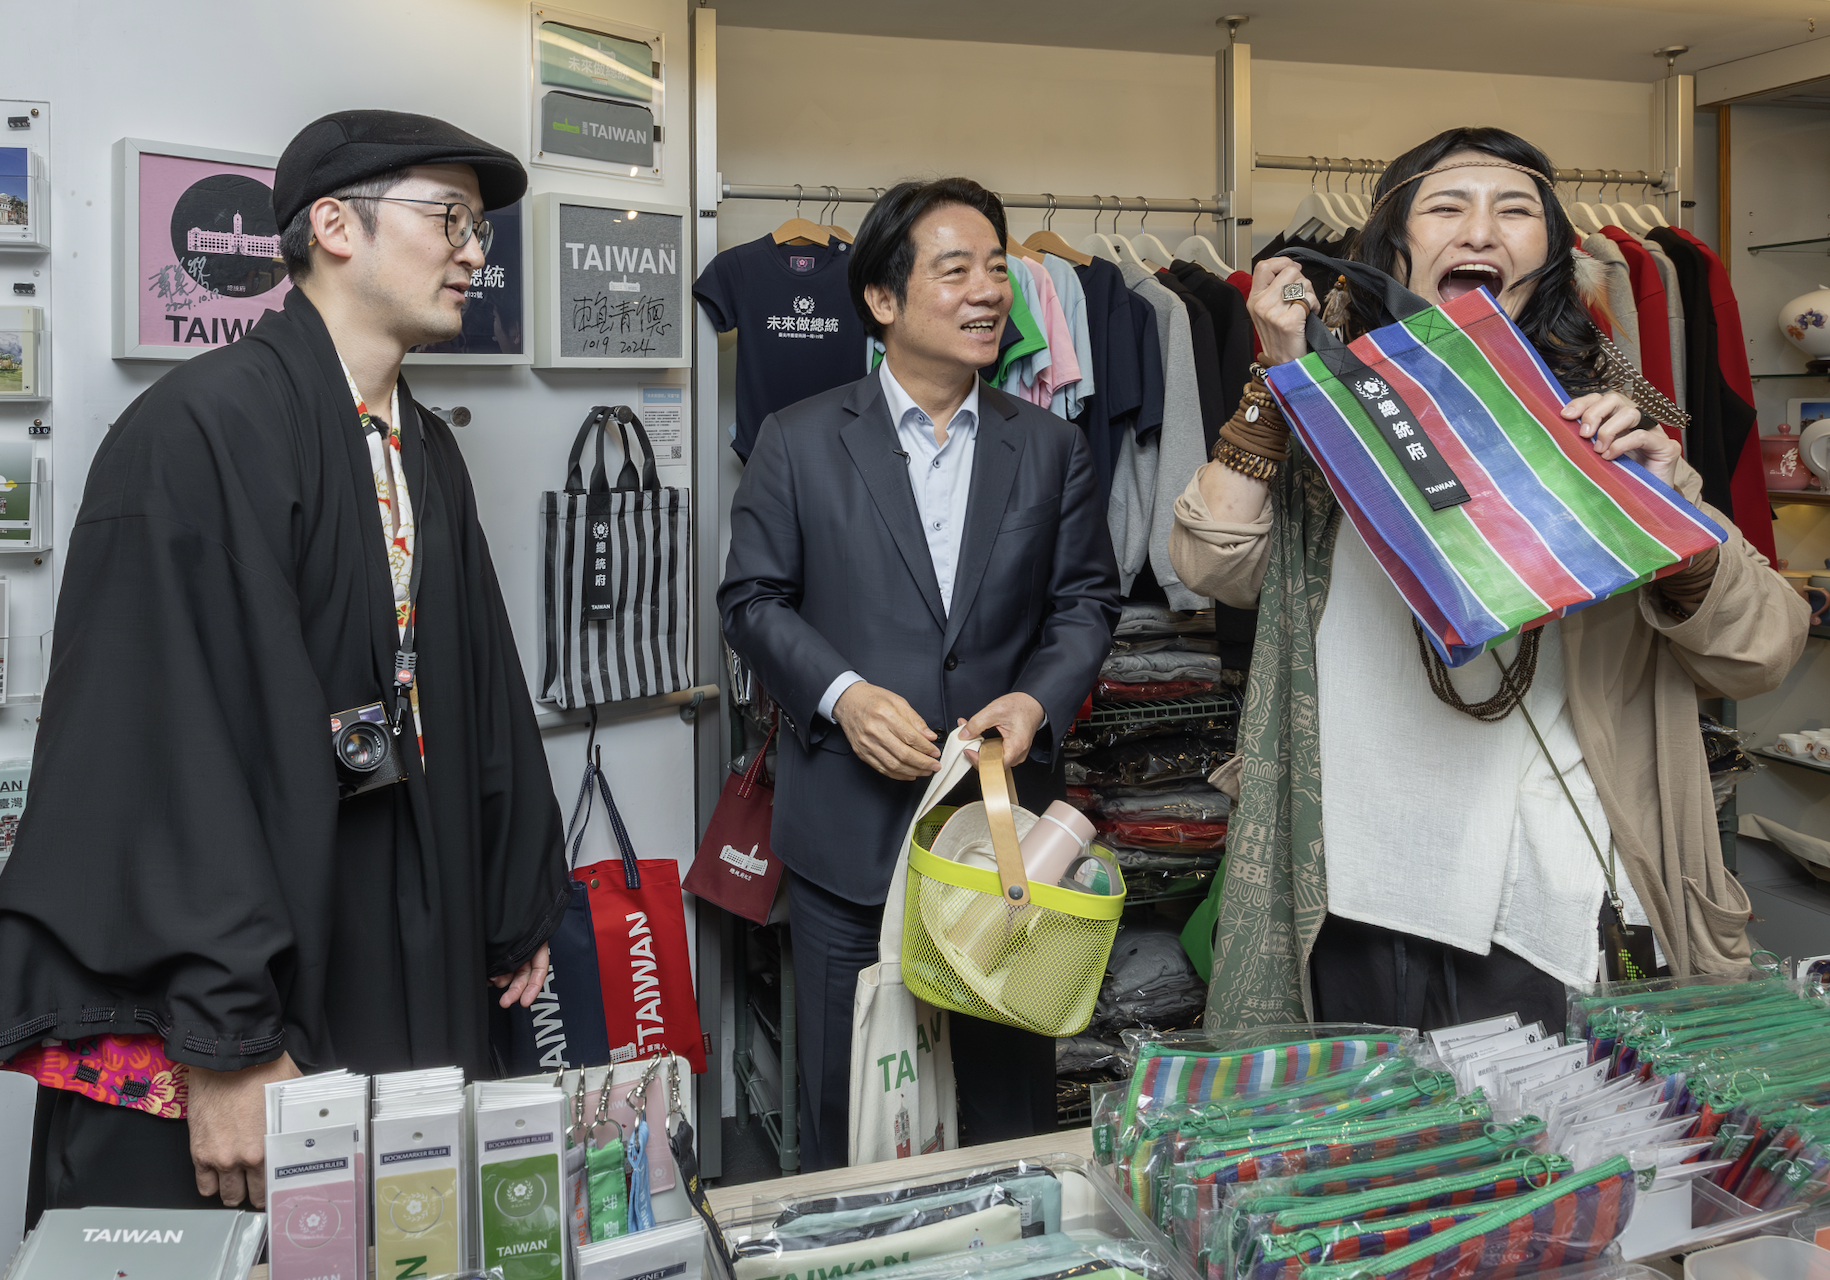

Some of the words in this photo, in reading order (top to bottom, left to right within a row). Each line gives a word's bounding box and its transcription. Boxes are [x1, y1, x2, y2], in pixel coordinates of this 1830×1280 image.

[589, 122, 647, 145] TAIWAN
[565, 242, 676, 275] TAIWAN
[165, 314, 254, 344] TAIW
[766, 315, 840, 333] 未來做總統
[620, 338, 656, 358] 2024
[1377, 399, 1428, 461] 總統府
[1425, 479, 1457, 495] TAIWAN
[595, 541, 607, 587] 總統府
[625, 911, 665, 1047] TAIWAN
[487, 1138, 531, 1149] BOOKMARKER
[531, 1135, 550, 1143] RULER
[383, 1150, 428, 1162] BOOKMARKER
[428, 1148, 447, 1156] RULER
[279, 1164, 325, 1176] BOOKMARKER
[325, 1160, 344, 1169] RULER
[602, 1194, 618, 1211] 我
[576, 1206, 585, 1220] is
[82, 1229, 184, 1244] TAIWAN
[496, 1239, 548, 1257] TAIWAN
